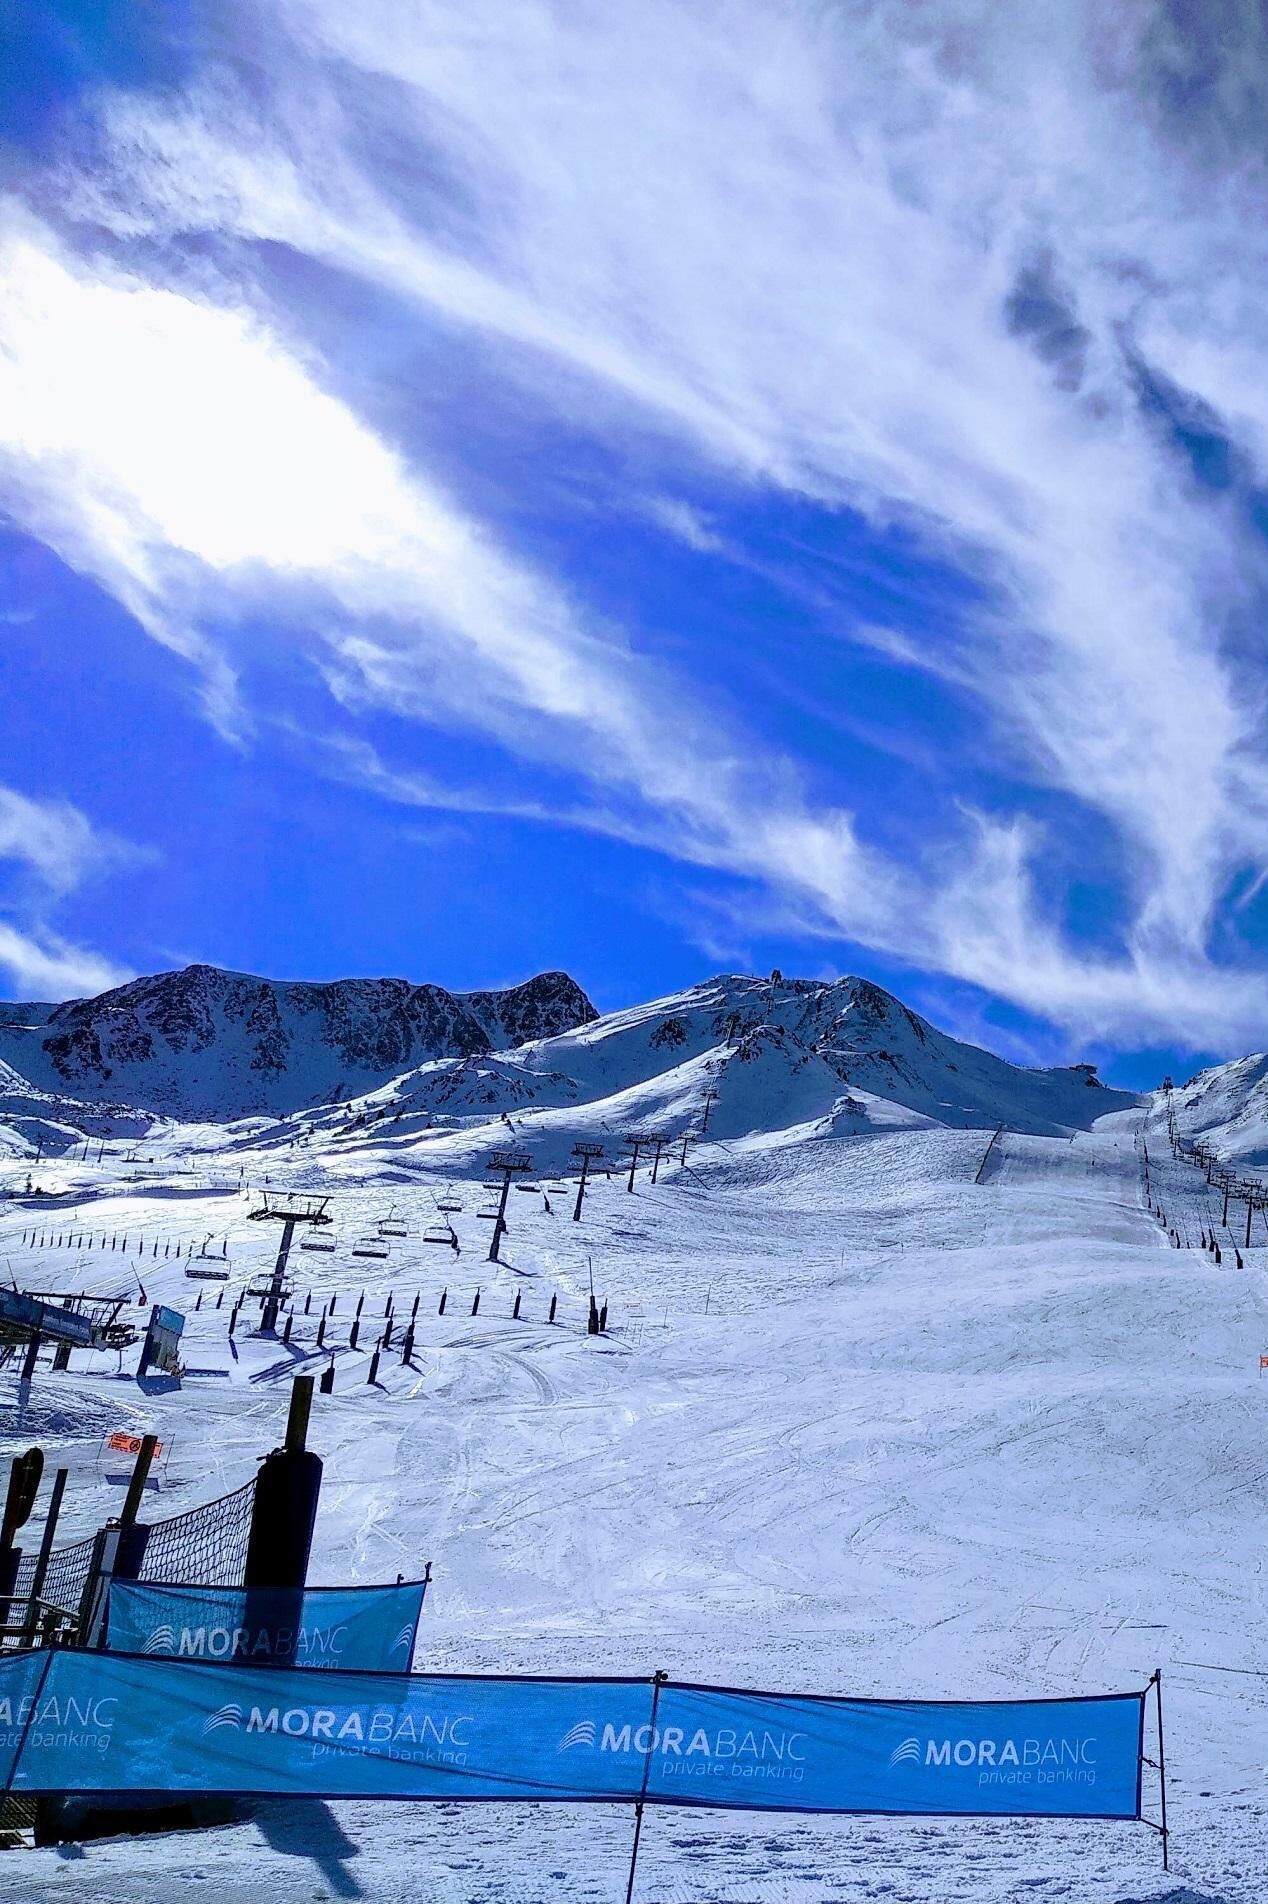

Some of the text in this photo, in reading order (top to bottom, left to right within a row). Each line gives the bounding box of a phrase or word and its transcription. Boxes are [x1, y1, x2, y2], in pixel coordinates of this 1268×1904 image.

[179, 1626, 348, 1656] MORABANC
[246, 1706, 474, 1746] MORABANC
[31, 1729, 111, 1753] banking
[312, 1742, 468, 1766] private banking
[600, 1722, 809, 1761] MORABANC
[925, 1738, 1097, 1766] MORABANC
[662, 1759, 804, 1781] private banking
[978, 1767, 1097, 1788] private banking
